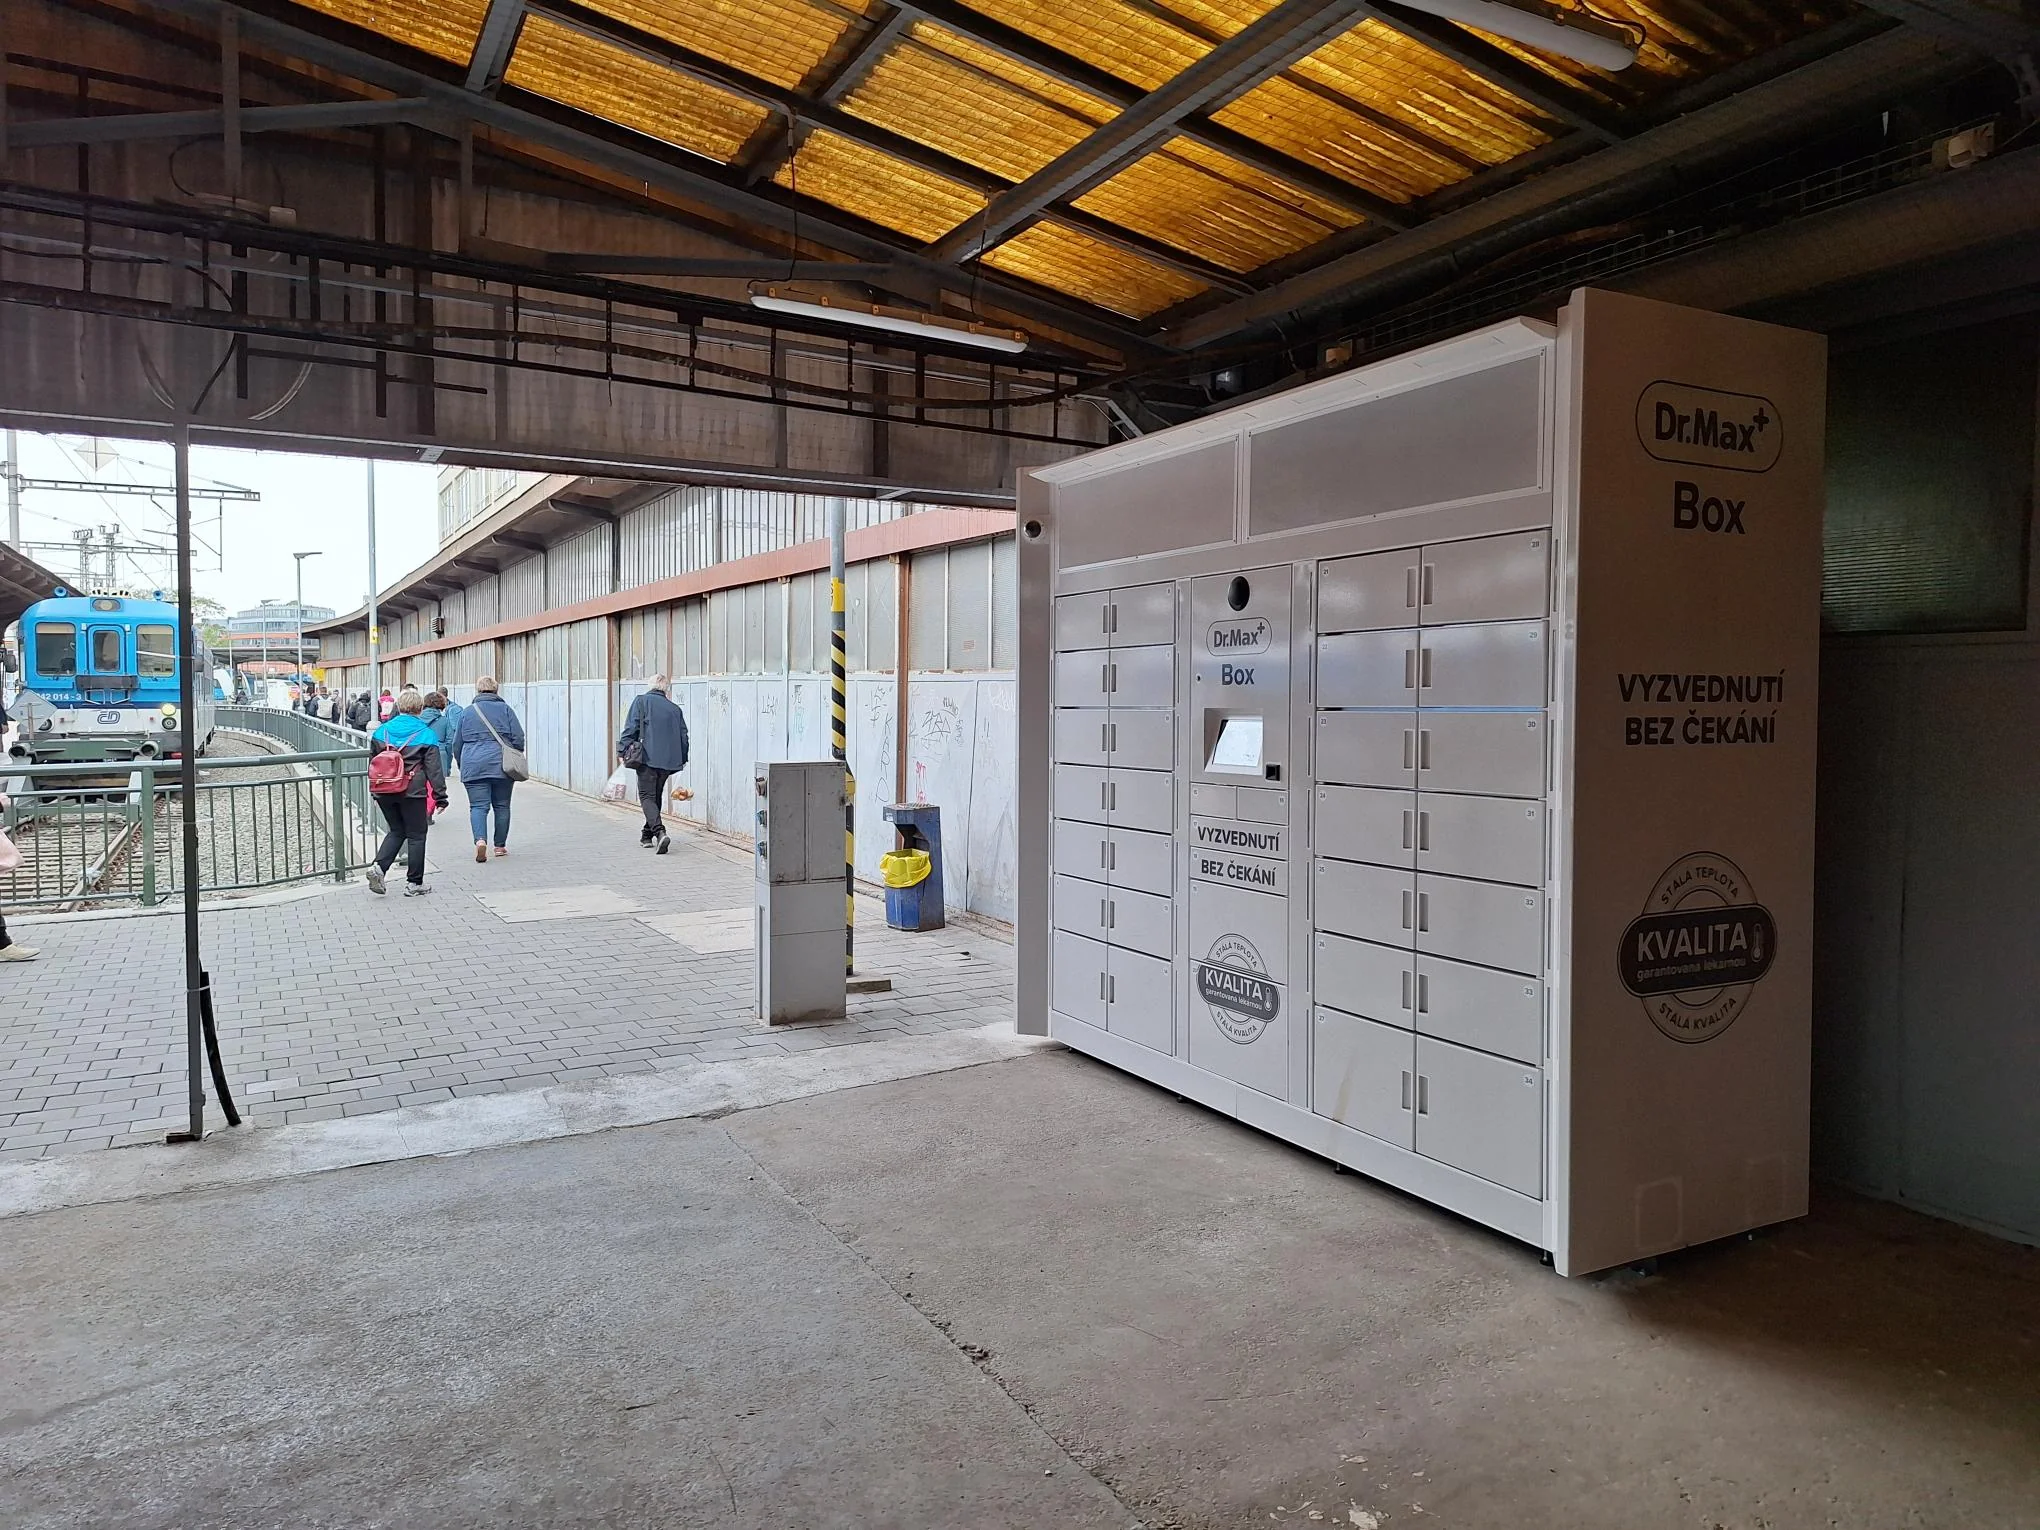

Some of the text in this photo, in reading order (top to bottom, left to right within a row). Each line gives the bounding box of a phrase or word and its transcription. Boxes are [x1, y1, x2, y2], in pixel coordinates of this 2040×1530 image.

[1674, 480, 1745, 535] Box
[1221, 663, 1255, 686] Box
[1617, 668, 1785, 703] VYZVEDNUTÍ
[1527, 720, 1536, 728] 30
[1625, 708, 1777, 745] BEZ ČEKÁNÍ
[1197, 825, 1280, 851] VYZVEDNUTÍ
[1201, 858, 1277, 886] BEZ ČEKÁNÍ
[1696, 866, 1738, 898] TEPLOTA
[1233, 942, 1258, 968] TEPLOTA
[1637, 921, 1748, 962] KVALITA
[1205, 967, 1263, 1001] KVALITA
[1692, 997, 1737, 1030] KVALITA
[1233, 1025, 1258, 1037] KVALITA
[1524, 1077, 1533, 1085] 34
